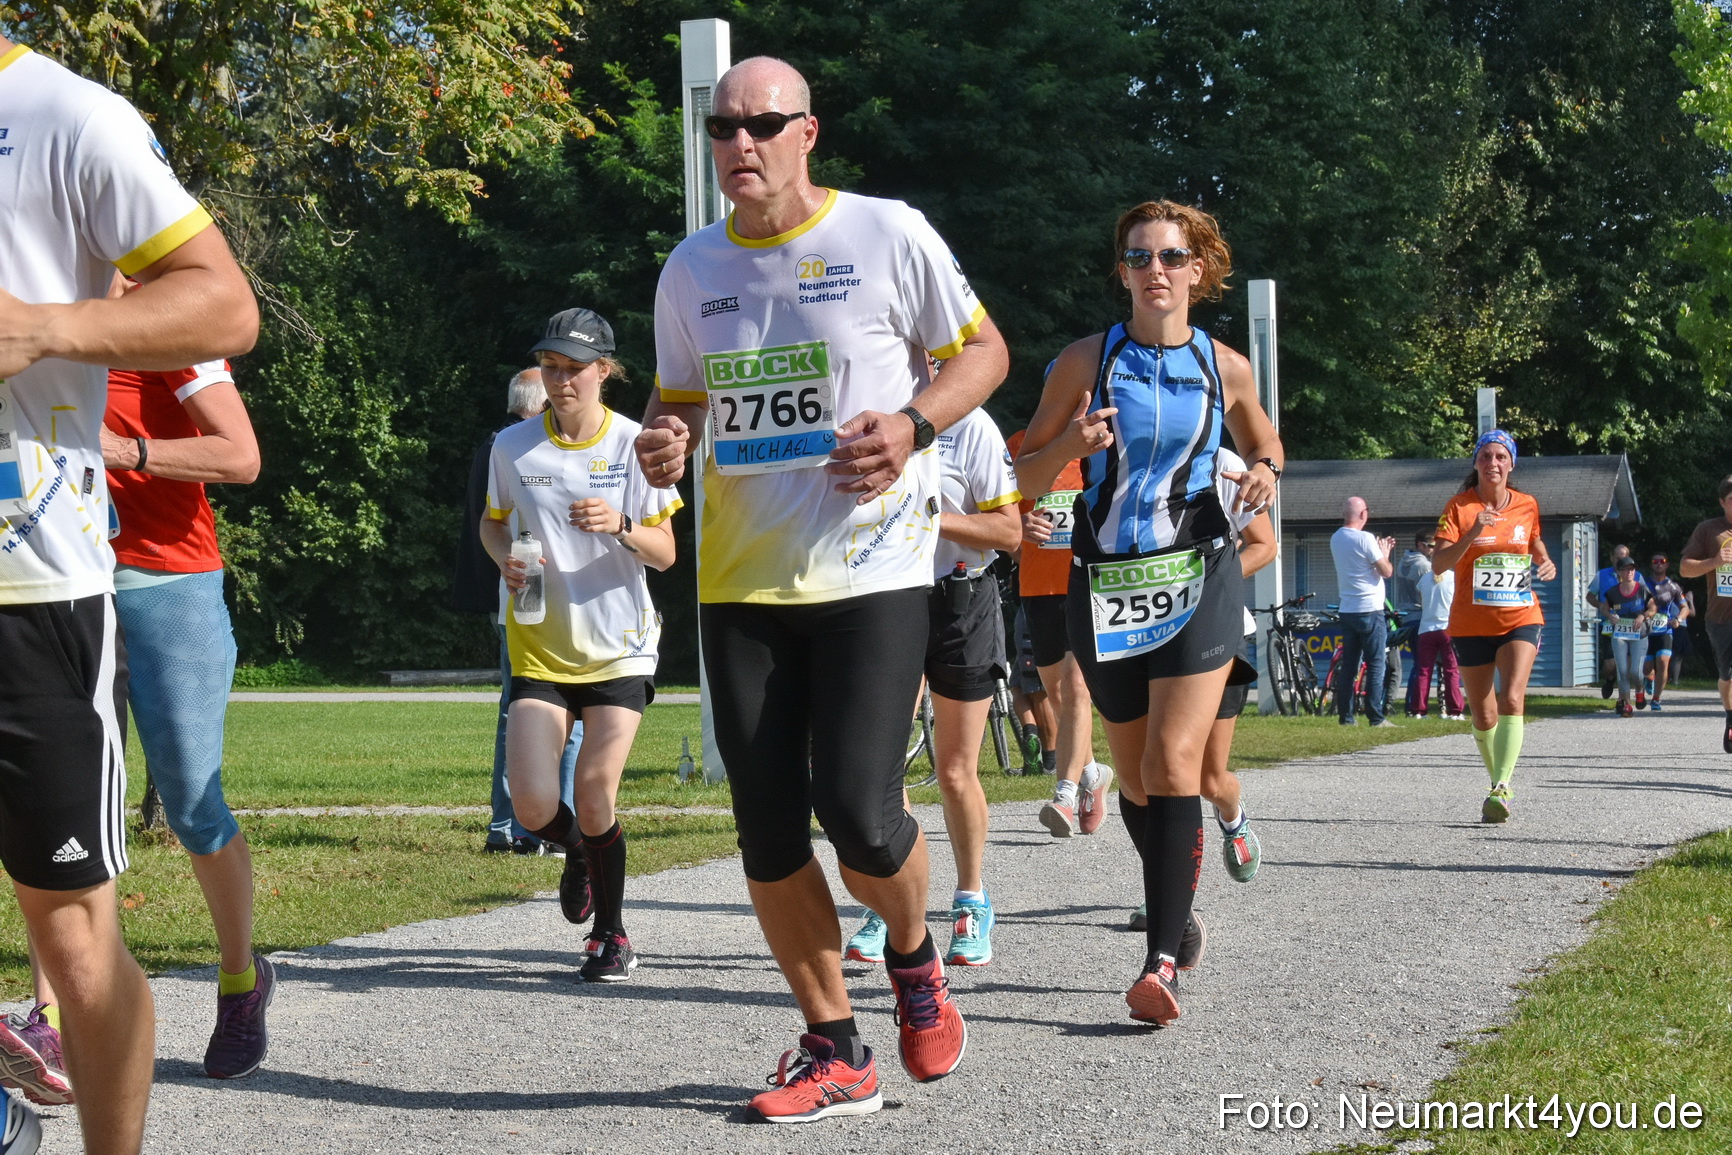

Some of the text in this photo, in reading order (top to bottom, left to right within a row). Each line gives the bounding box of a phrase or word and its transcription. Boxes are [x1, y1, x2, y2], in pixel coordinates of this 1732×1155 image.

[800, 260, 853, 279] 20 JAHRE
[799, 278, 861, 291] Neumarkter
[799, 290, 849, 304] Stadtlauf
[702, 297, 739, 315] BOCK
[711, 350, 815, 384] BOCK
[720, 387, 823, 432] 2766
[737, 438, 814, 463] MICHAEL
[591, 460, 608, 472] 20
[521, 476, 551, 484] BOCK
[590, 480, 621, 488] Stadtlauf
[869, 511, 902, 549] September
[901, 492, 912, 511] 2019
[1479, 556, 1526, 567] BOCK
[1100, 559, 1192, 587] BOCK
[1481, 572, 1525, 588] 2272
[1486, 592, 1520, 600] BIANKA
[1106, 586, 1190, 627] 2591
[1126, 622, 1176, 646] SILVIA
[1210, 644, 1225, 655] cep
[52, 849, 89, 862] adidas
